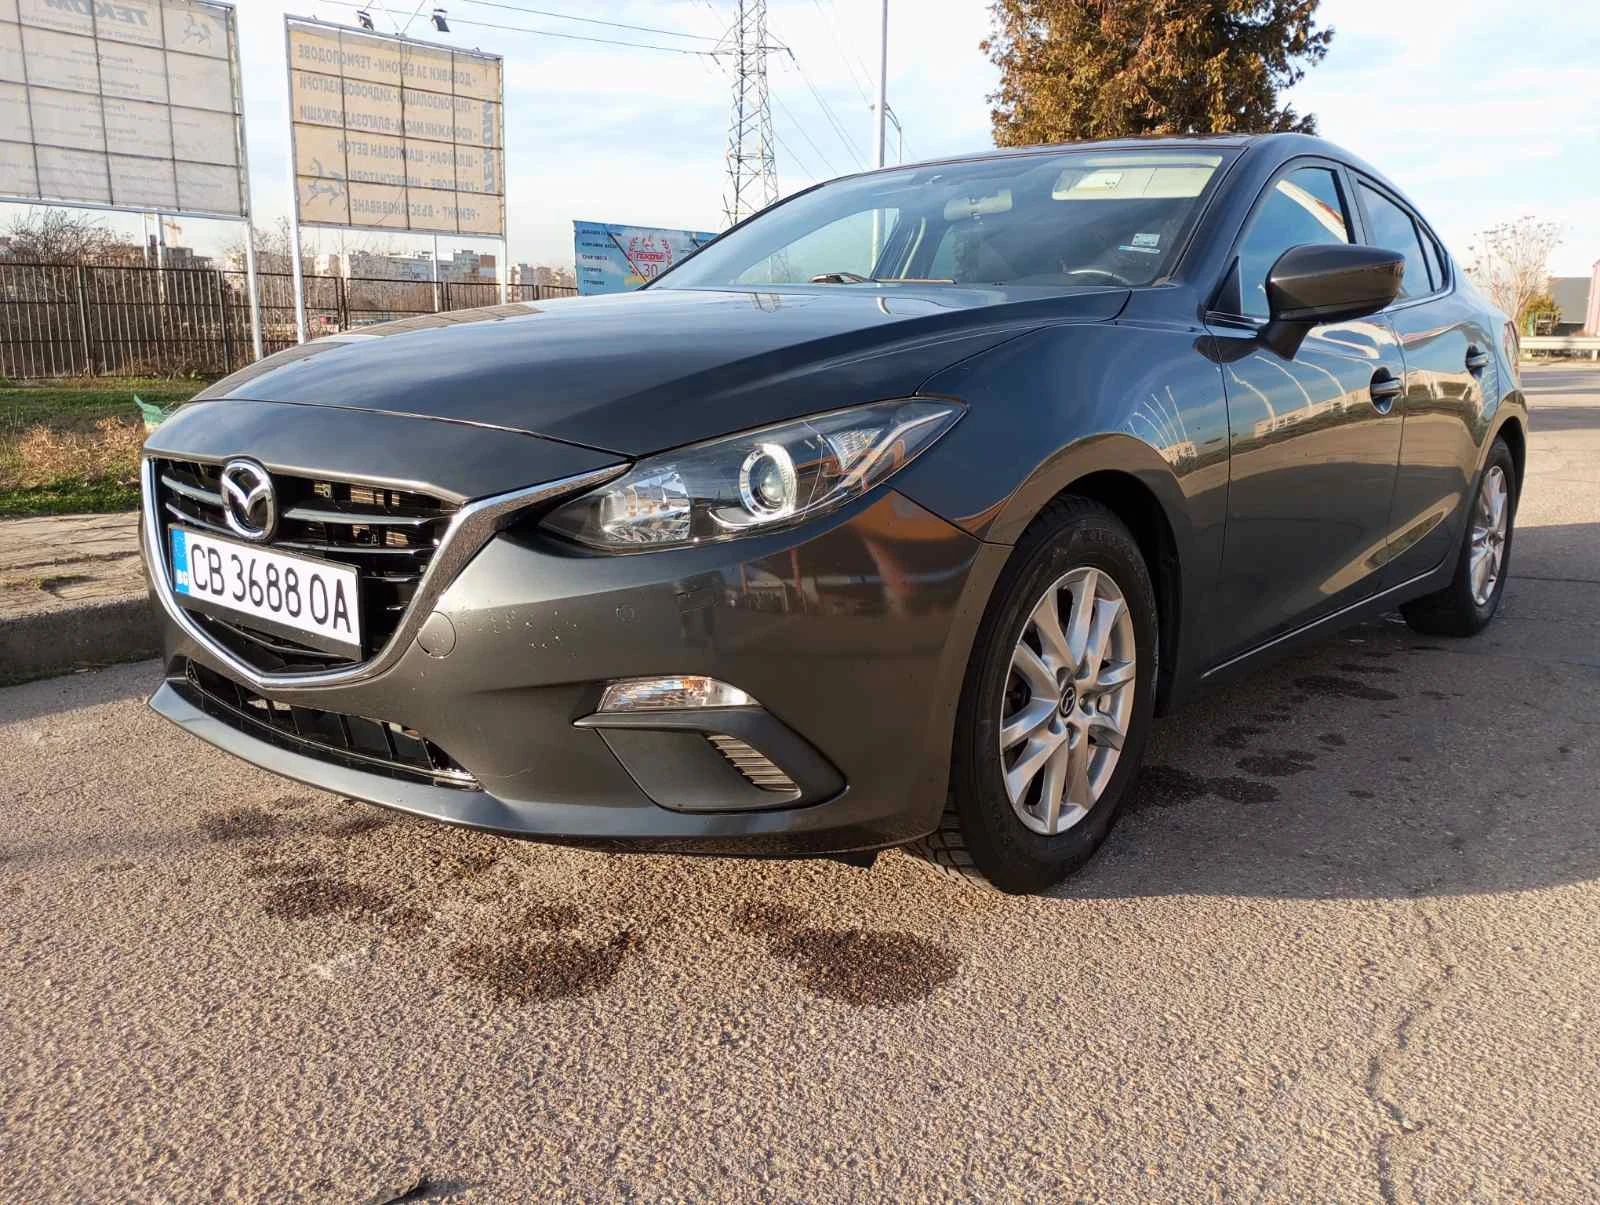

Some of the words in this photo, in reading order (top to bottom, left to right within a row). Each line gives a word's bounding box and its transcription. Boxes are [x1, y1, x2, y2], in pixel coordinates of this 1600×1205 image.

[191, 544, 225, 596] CB
[231, 554, 301, 617] 3688
[309, 573, 352, 634] OA
